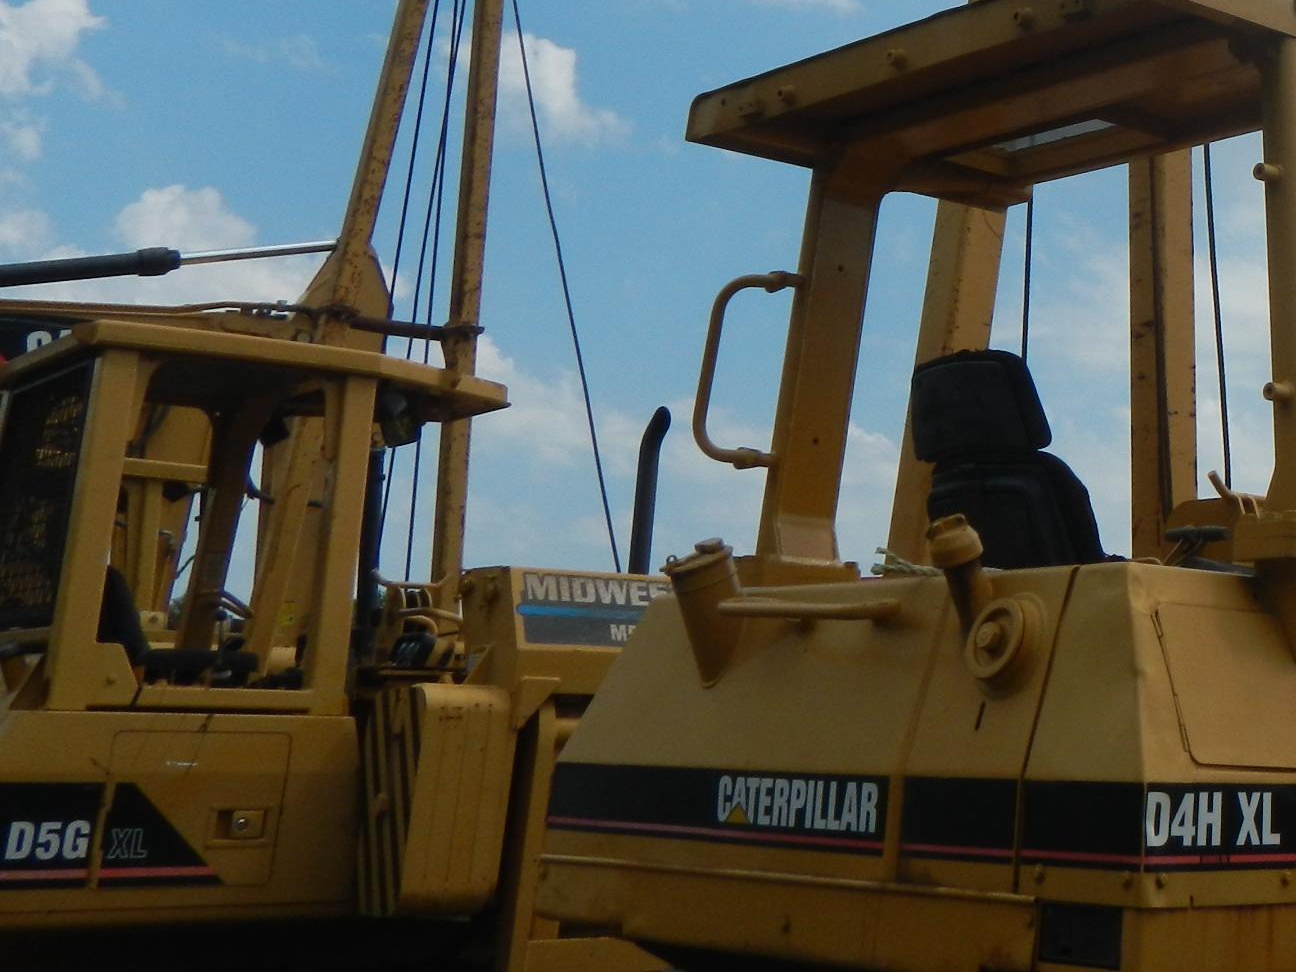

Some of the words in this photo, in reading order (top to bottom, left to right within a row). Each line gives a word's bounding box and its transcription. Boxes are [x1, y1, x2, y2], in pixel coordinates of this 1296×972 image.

[717, 775, 879, 832] CATERPILLAR
[1146, 791, 1223, 847] D4H
[1236, 791, 1281, 846] XL
[4, 819, 91, 860] D5G
[106, 828, 148, 859] XL
